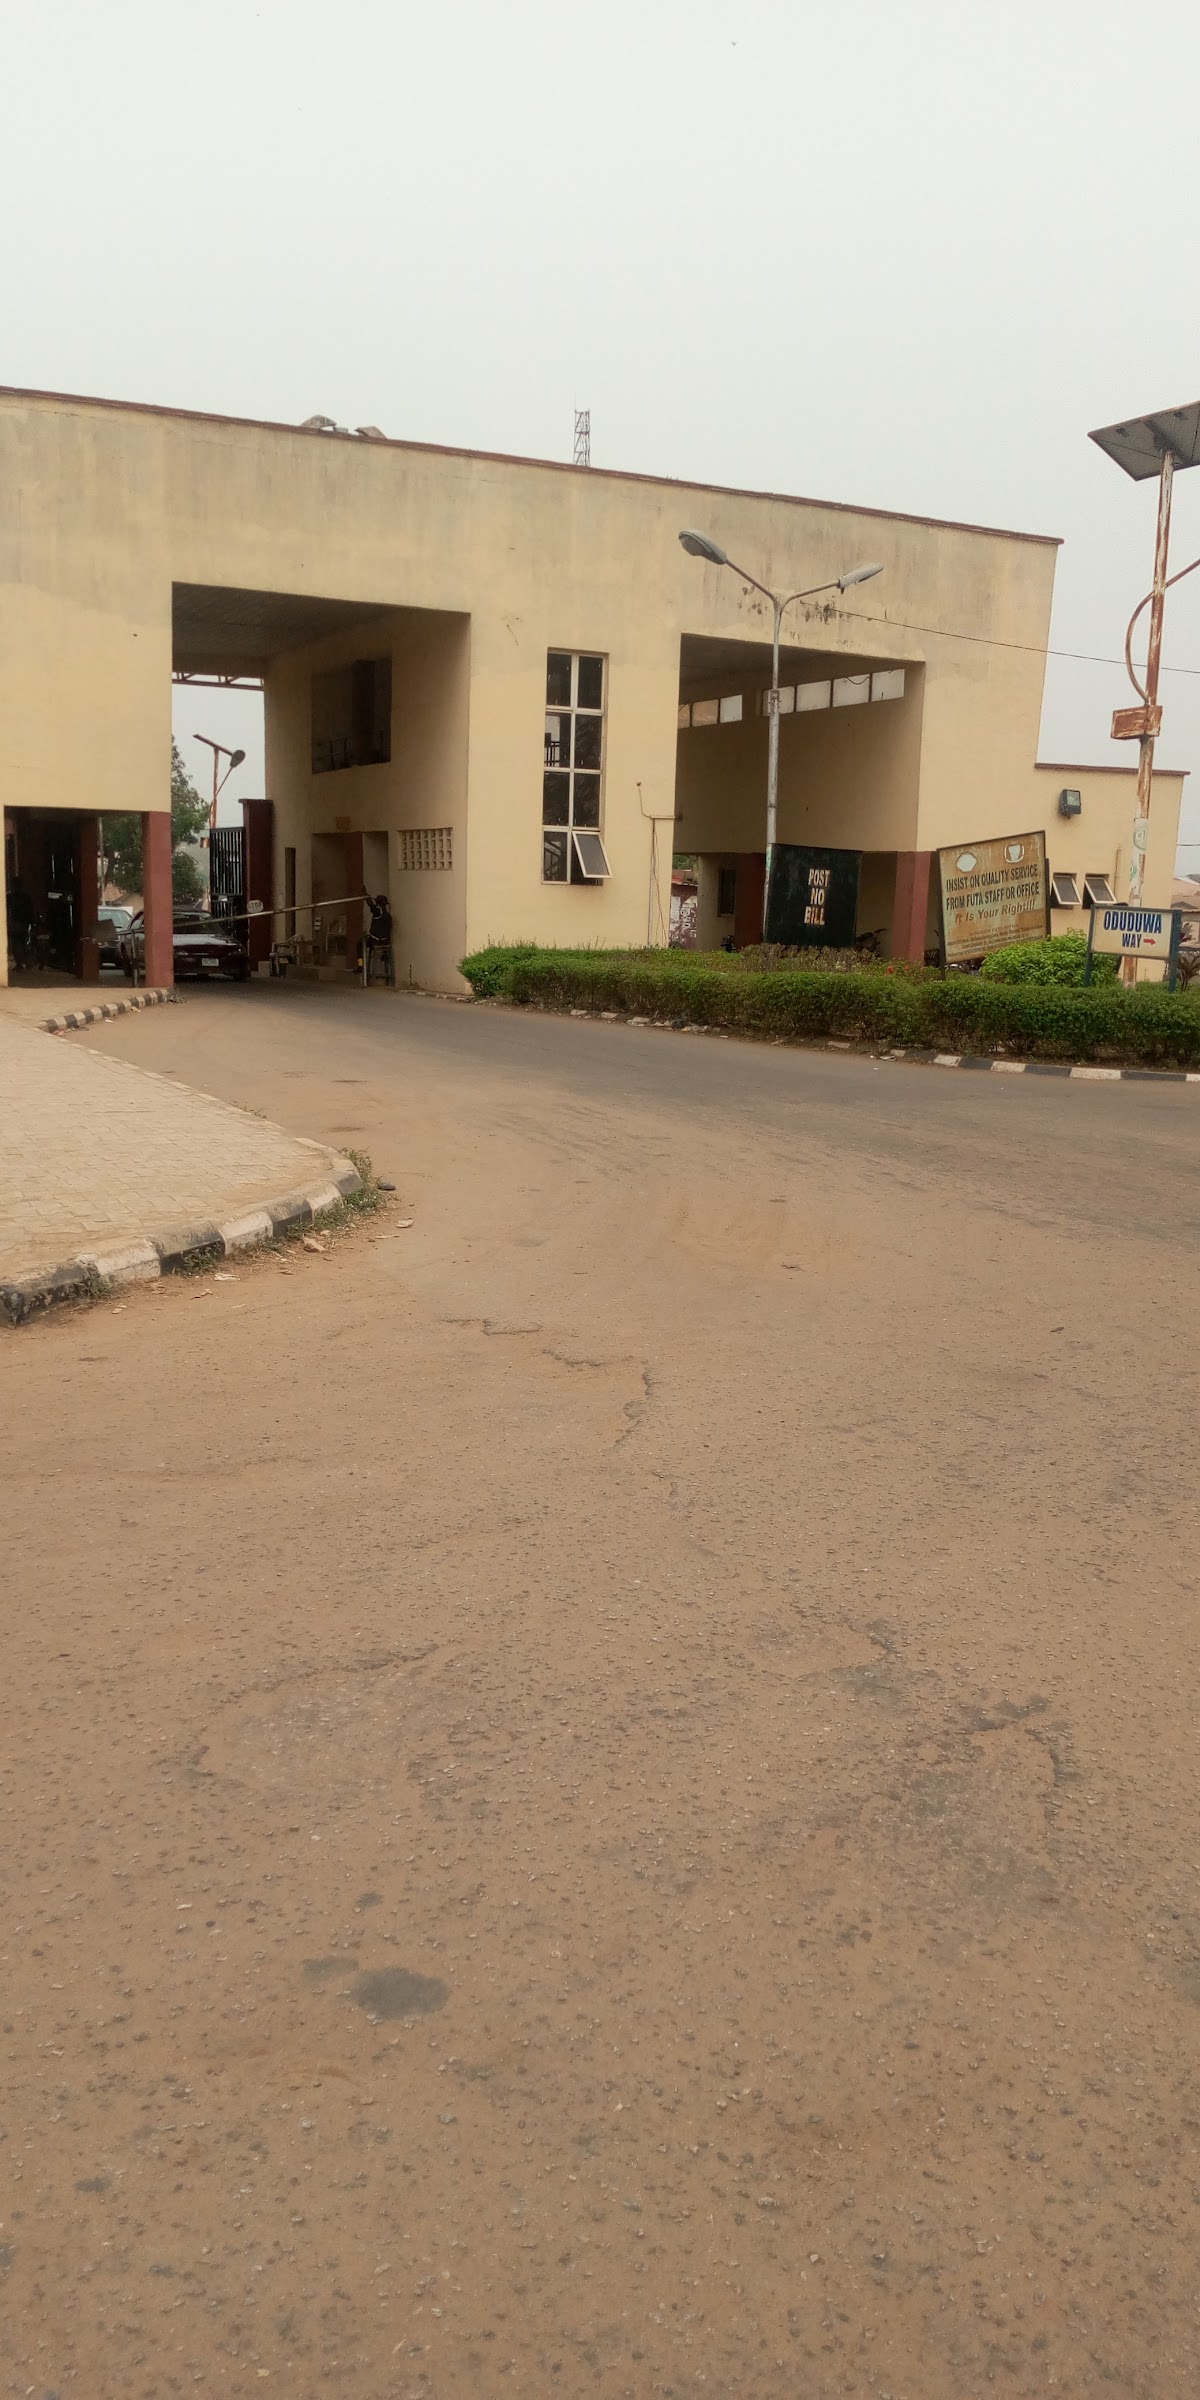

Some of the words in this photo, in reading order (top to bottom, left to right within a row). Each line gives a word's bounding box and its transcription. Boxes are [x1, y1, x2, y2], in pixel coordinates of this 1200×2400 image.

[808, 868, 830, 887] POST
[946, 876, 968, 892] INSIST
[970, 874, 980, 888] ON
[981, 869, 1009, 886] QUALITY
[1010, 864, 1038, 881] SERVICE
[810, 887, 825, 905] NO
[946, 895, 965, 910] FROM
[966, 892, 984, 907] FUTA
[985, 888, 1005, 904] STAFF
[1005, 886, 1015, 900] OR
[1016, 882, 1040, 898] OFFICE
[804, 906, 825, 925] BILL
[965, 911, 974, 921] Is
[978, 908, 999, 919] Your
[1104, 911, 1161, 934] ODUDUWA
[1122, 933, 1142, 948] WAY
